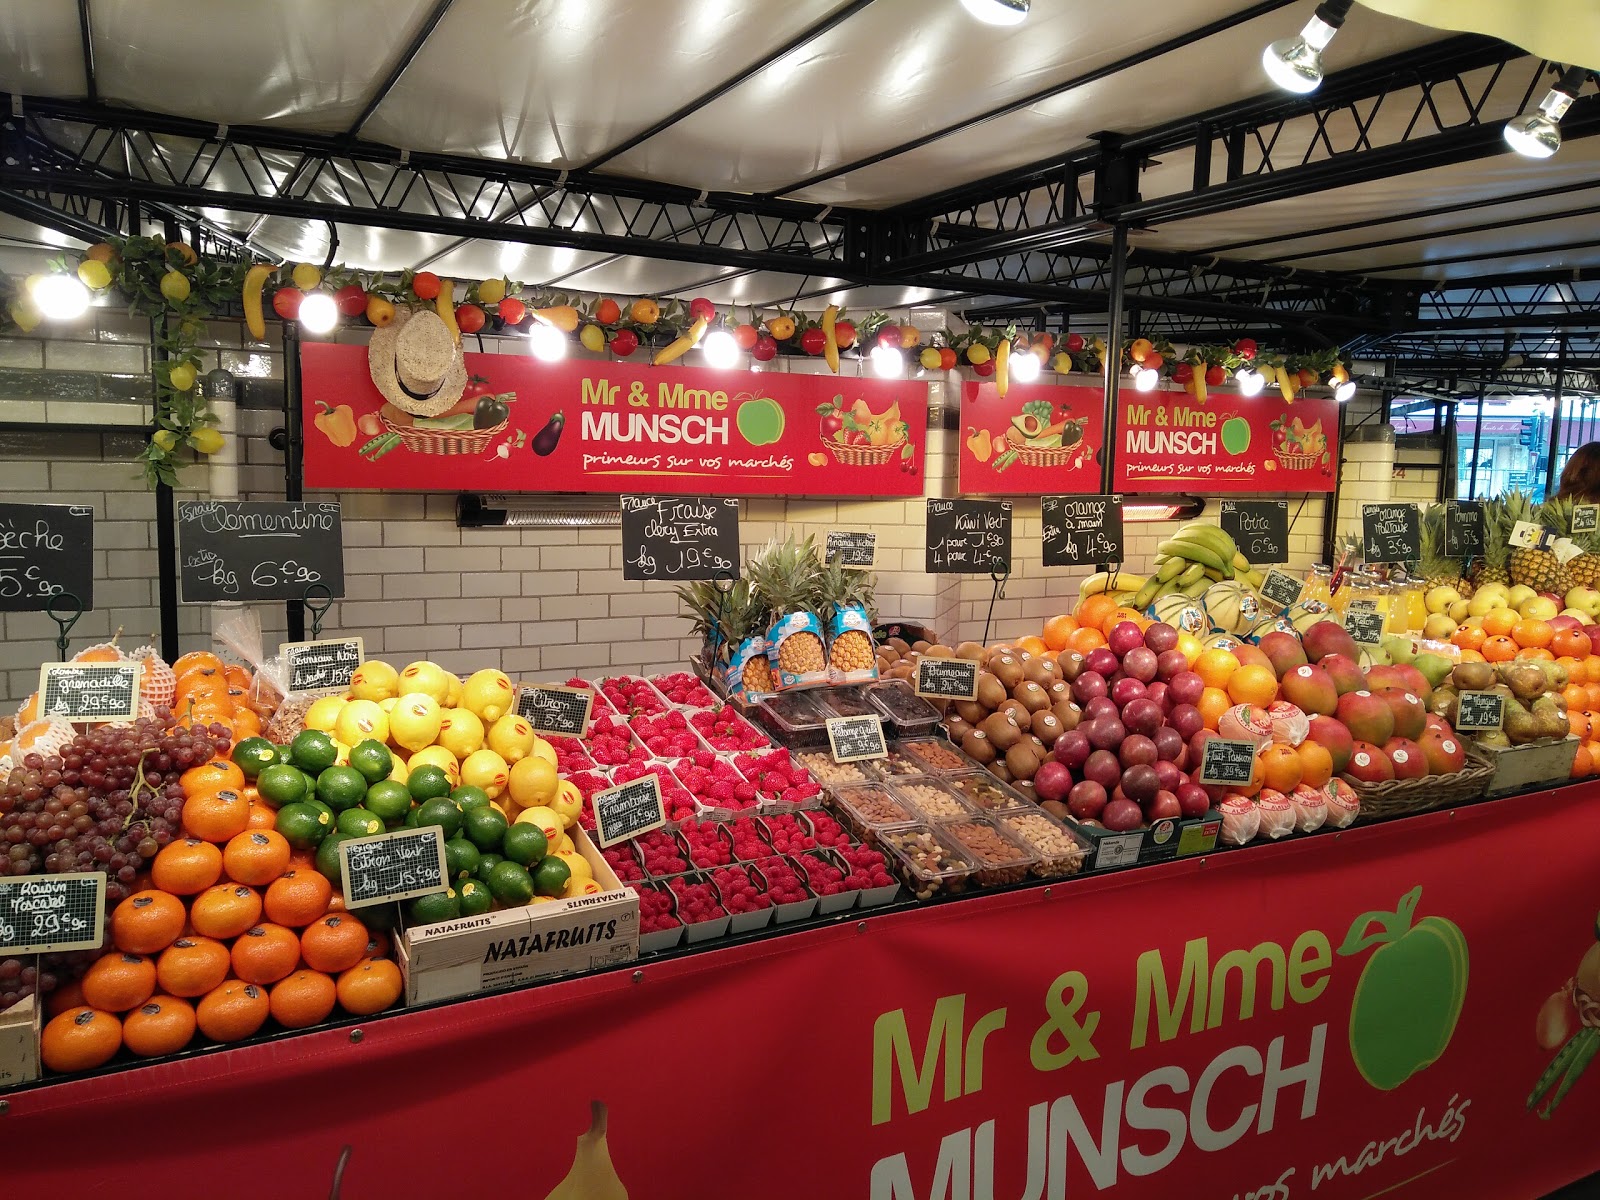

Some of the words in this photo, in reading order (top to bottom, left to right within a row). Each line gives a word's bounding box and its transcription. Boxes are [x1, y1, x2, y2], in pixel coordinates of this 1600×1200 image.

[581, 377, 621, 405] Mr
[627, 381, 650, 407] &
[658, 382, 728, 410] Mme
[581, 411, 729, 445] MUNSCH
[1127, 404, 1151, 426] Mr
[1154, 405, 1169, 426] &
[1173, 406, 1217, 428] Mme
[1126, 430, 1217, 455] MUNSCH
[582, 451, 661, 470] primeurs
[666, 455, 694, 469] sur
[699, 455, 722, 469] vos
[728, 454, 795, 471] marchés
[1126, 461, 1175, 477] primeurs
[1177, 463, 1195, 475] sur
[1197, 464, 1212, 475] vos
[1215, 461, 1256, 476] marchés
[657, 497, 717, 524] Fraise
[955, 513, 980, 530] Kiwi
[983, 511, 1009, 530] Vert
[1240, 511, 1270, 531] Poire
[0, 519, 64, 551] èche
[351, 854, 391, 871] Citron
[396, 844, 424, 860] Vert
[566, 891, 627, 909] NATAFRUITS
[425, 916, 492, 936] NATAFRUITS
[483, 919, 618, 965] NATAFRUITS
[871, 993, 1007, 1126] Mr
[1029, 970, 1101, 1072] &
[1130, 929, 1332, 1050] Mme
[869, 1022, 1329, 1200] MUNSCH
[1311, 1092, 1472, 1191] marchés
